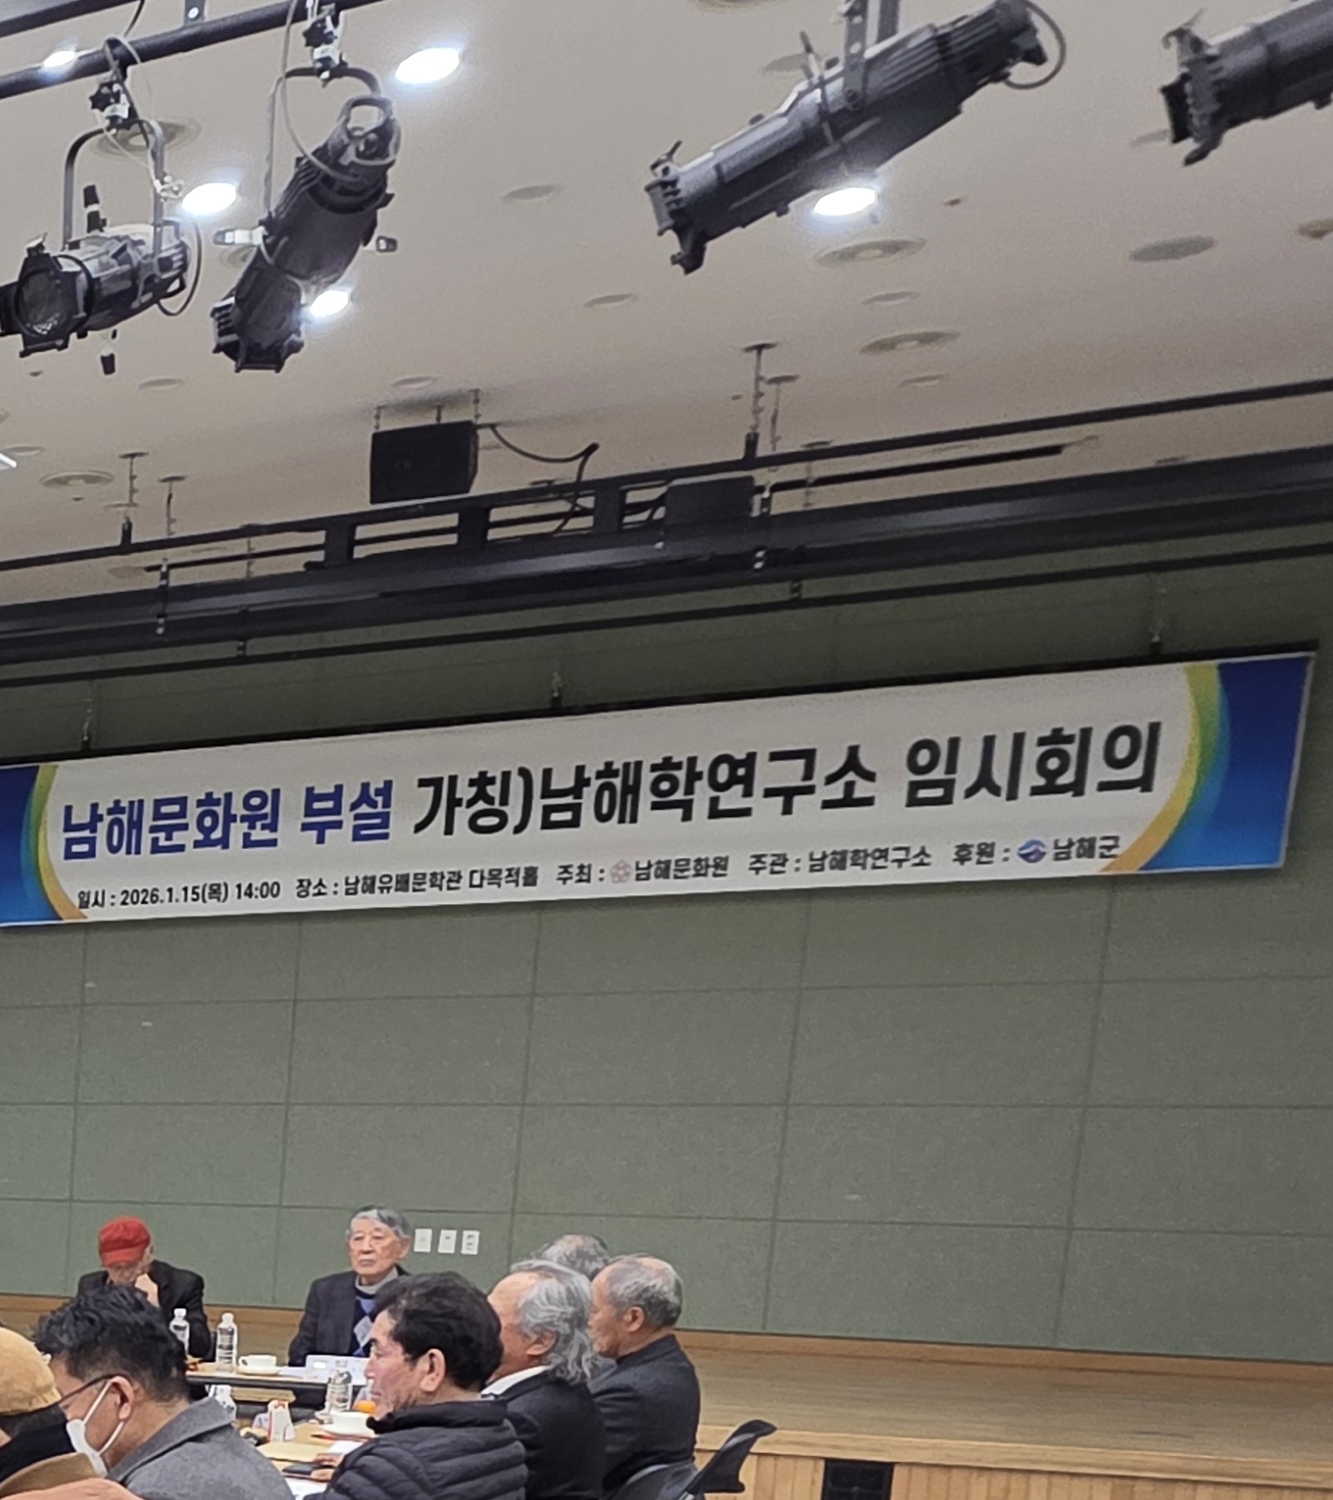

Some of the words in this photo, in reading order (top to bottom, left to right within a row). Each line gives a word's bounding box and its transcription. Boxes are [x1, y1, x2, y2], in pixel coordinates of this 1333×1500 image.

[62, 787, 281, 861] 남해문화원
[300, 779, 393, 845] 부설
[413, 744, 877, 836] 가칭)남해학연구소
[905, 721, 1162, 808] 임시회의
[77, 889, 106, 909] 일시
[119, 882, 229, 906] 2026.1.15(목)
[235, 881, 281, 900] 14:00
[296, 878, 328, 898] 장소
[344, 871, 463, 896] 남해유배문학관
[556, 863, 592, 885] 주최
[634, 855, 729, 881] 남해문화원
[748, 852, 789, 875] 주관
[808, 846, 932, 873] 남해학연구소
[952, 841, 996, 865] 후원
[1052, 835, 1120, 862] 남해군
